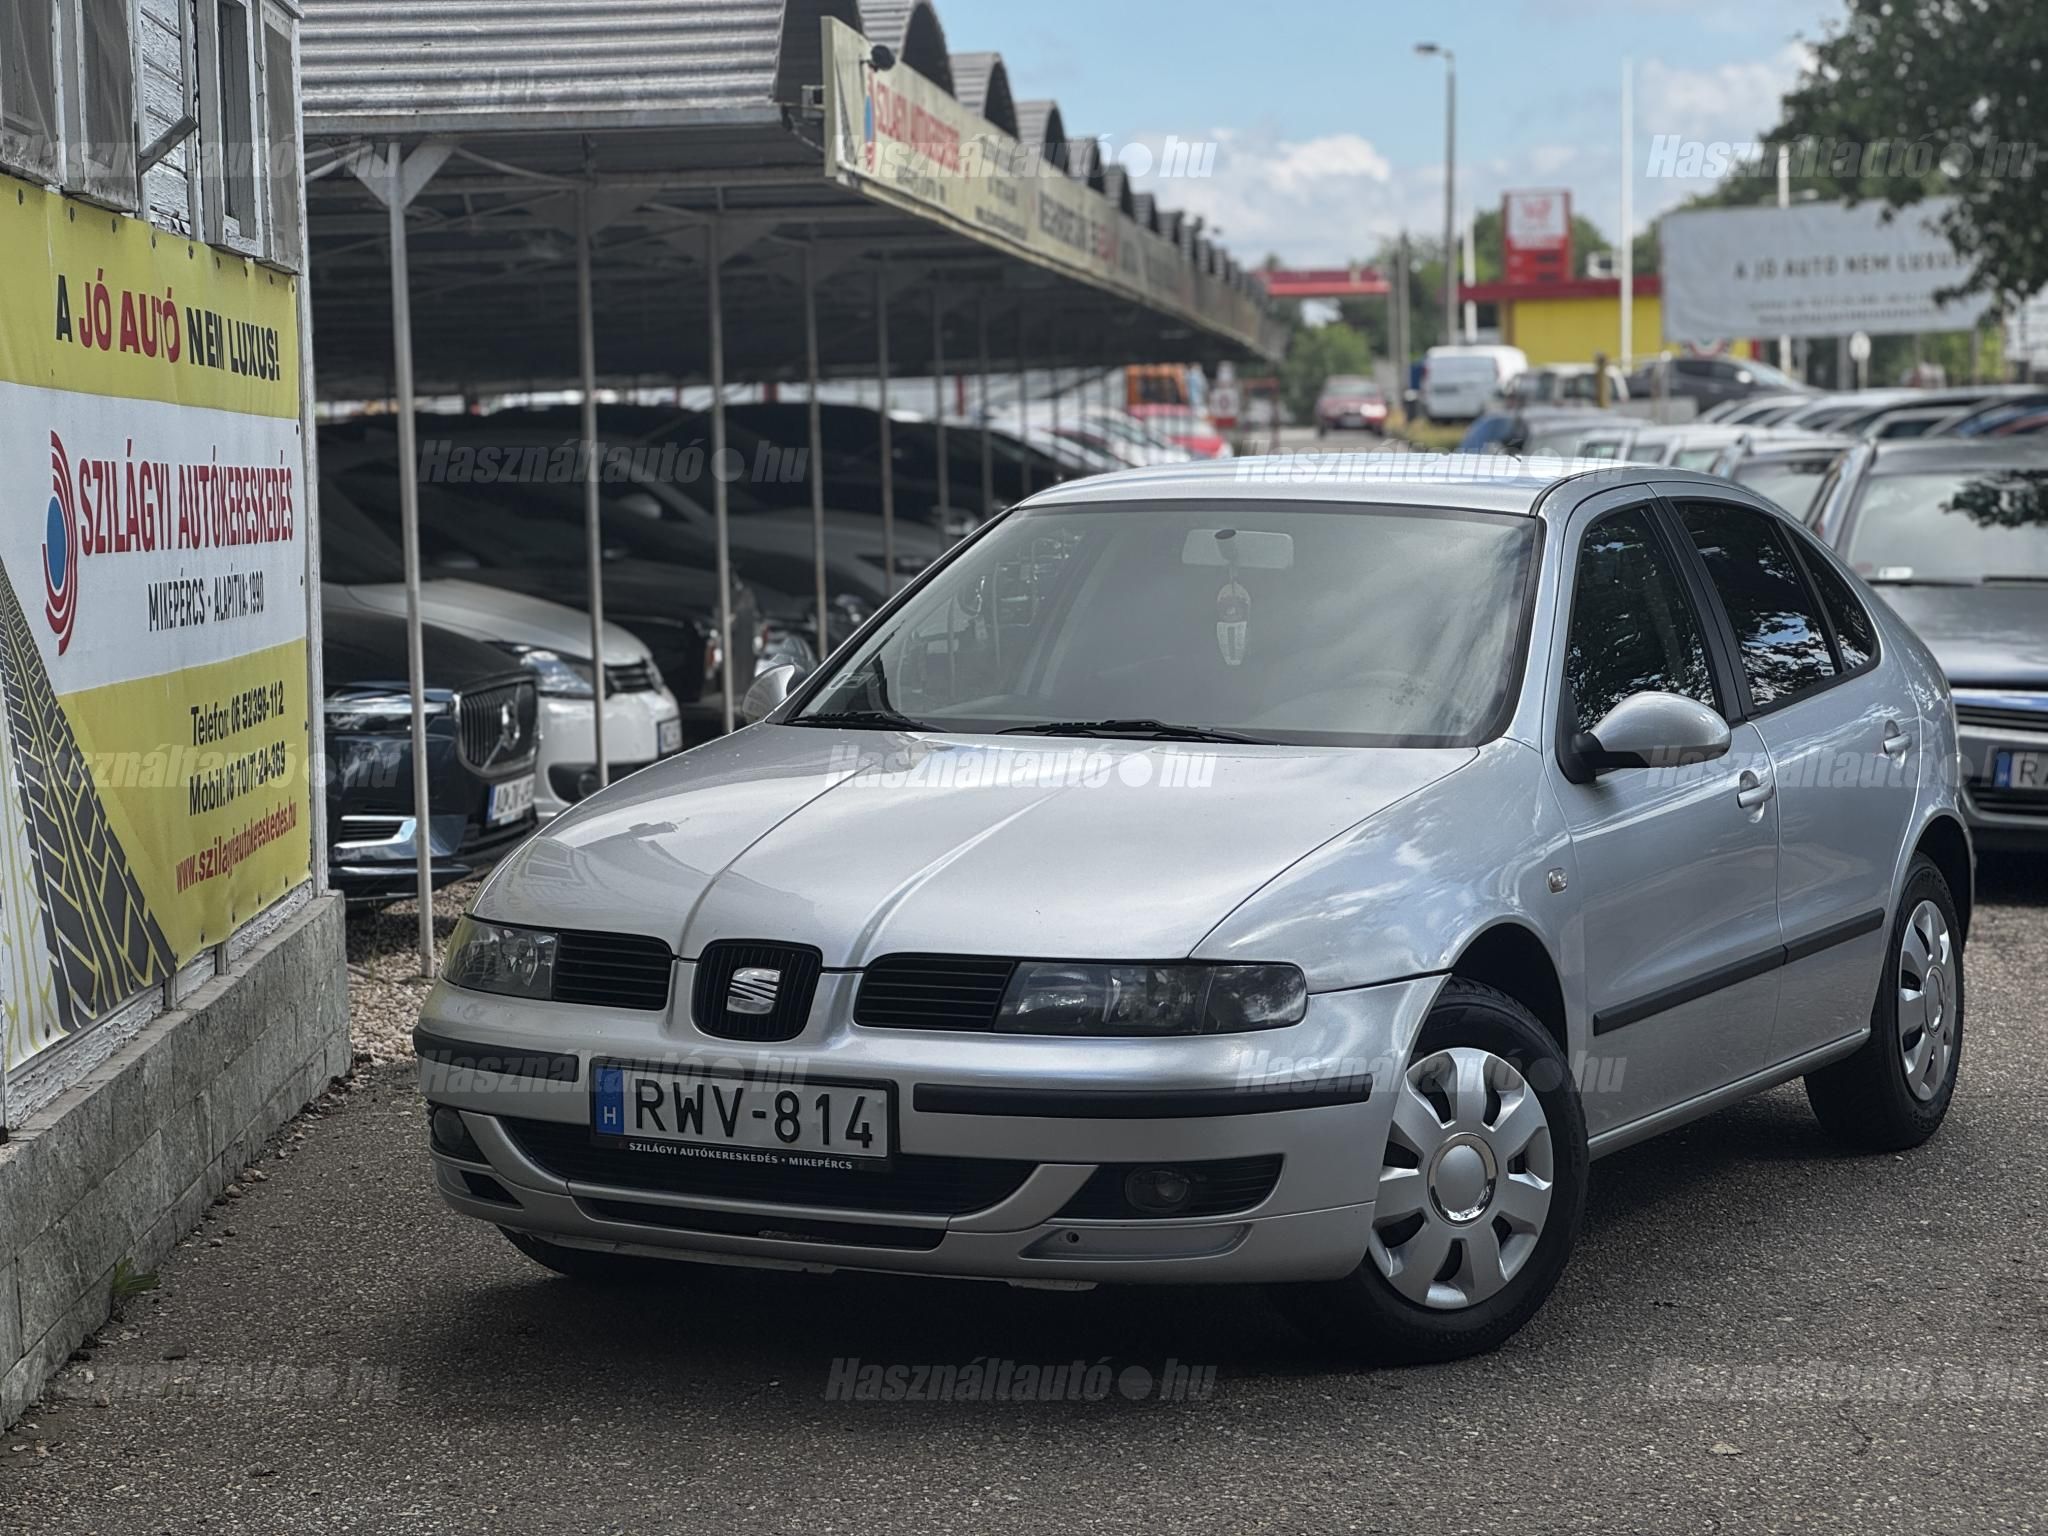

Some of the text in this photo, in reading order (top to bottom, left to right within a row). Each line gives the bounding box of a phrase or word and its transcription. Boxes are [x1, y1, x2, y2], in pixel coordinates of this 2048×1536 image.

[56, 268, 281, 381] A JÓ AUTÓ NEM LUXUS!
[79, 438, 294, 557] SZILÁGYI AUTÓKERESKEDÉS
[148, 567, 205, 632] MIKEPÉRCS
[214, 562, 248, 622] ALAPÍTVA:
[231, 695, 240, 734] 06
[189, 768, 226, 817] Mobil:
[2018, 759, 2048, 784] R
[603, 1078, 873, 1149] H RWV-814
[629, 1142, 853, 1170] SZILÁGYI AUTÓKERESKEDÉS MIKEPÉRCS
